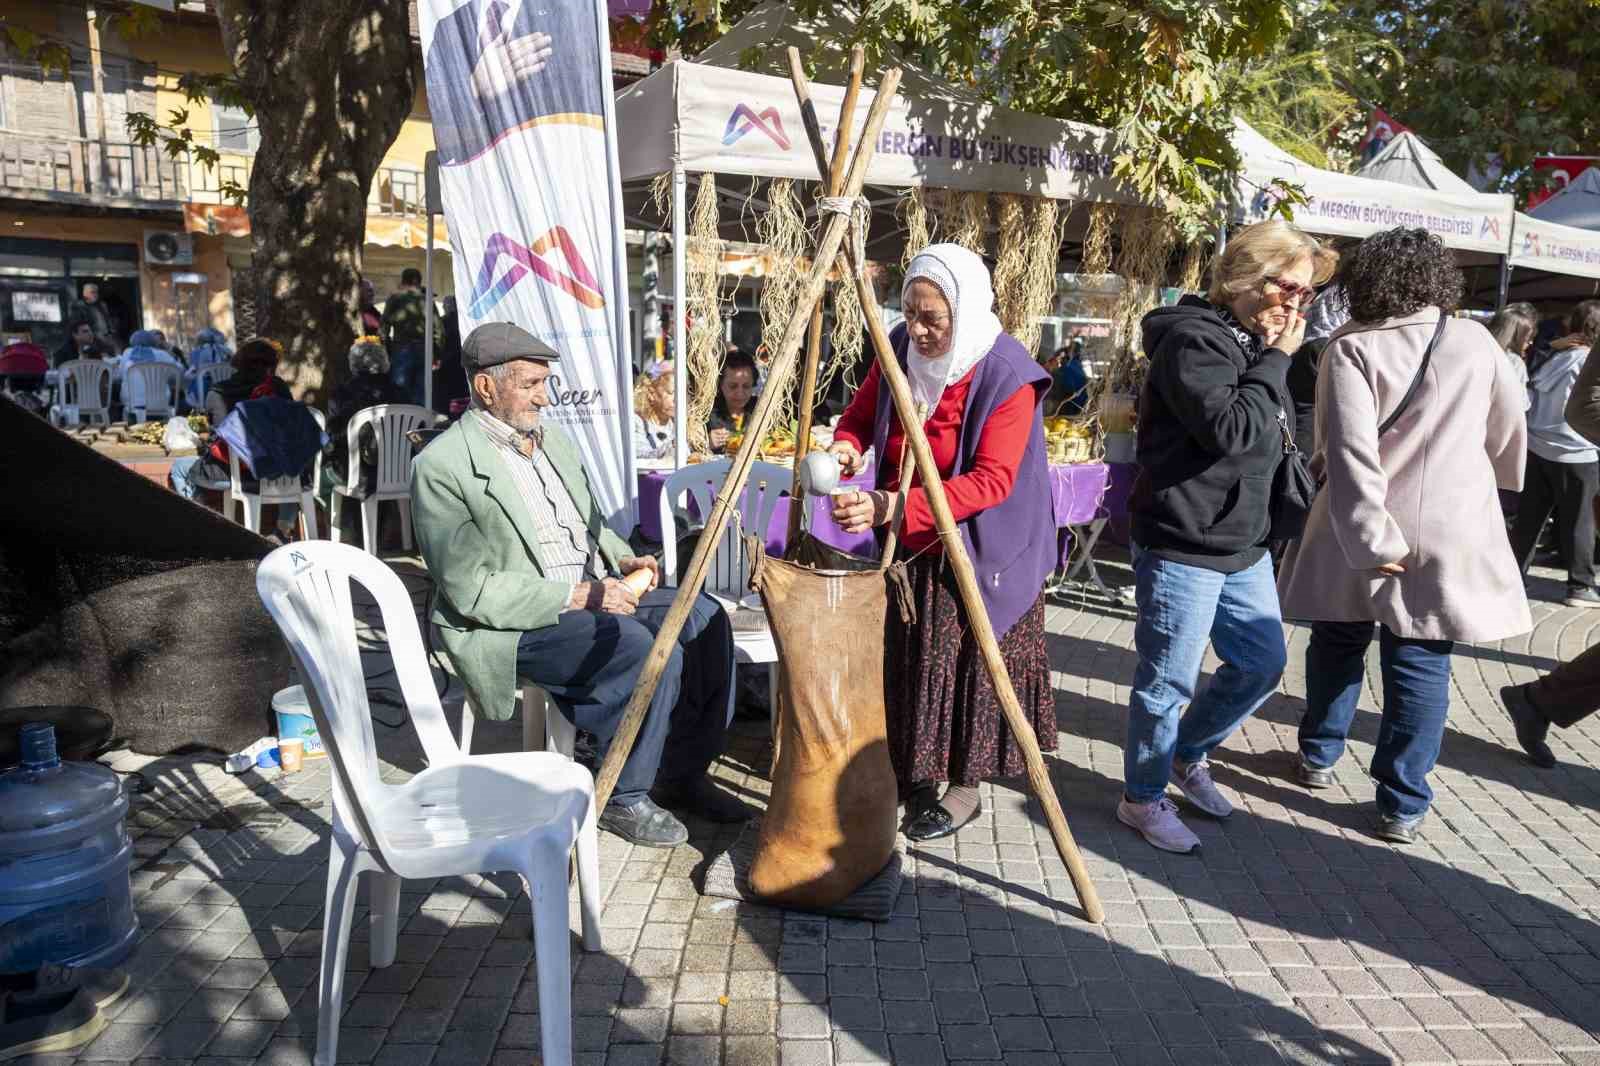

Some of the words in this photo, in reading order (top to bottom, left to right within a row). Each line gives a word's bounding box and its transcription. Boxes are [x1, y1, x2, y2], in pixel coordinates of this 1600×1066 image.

[875, 126, 943, 158] ERSİN
[1320, 199, 1361, 222] MERSİN
[1427, 215, 1473, 236] BELEDİYESİ
